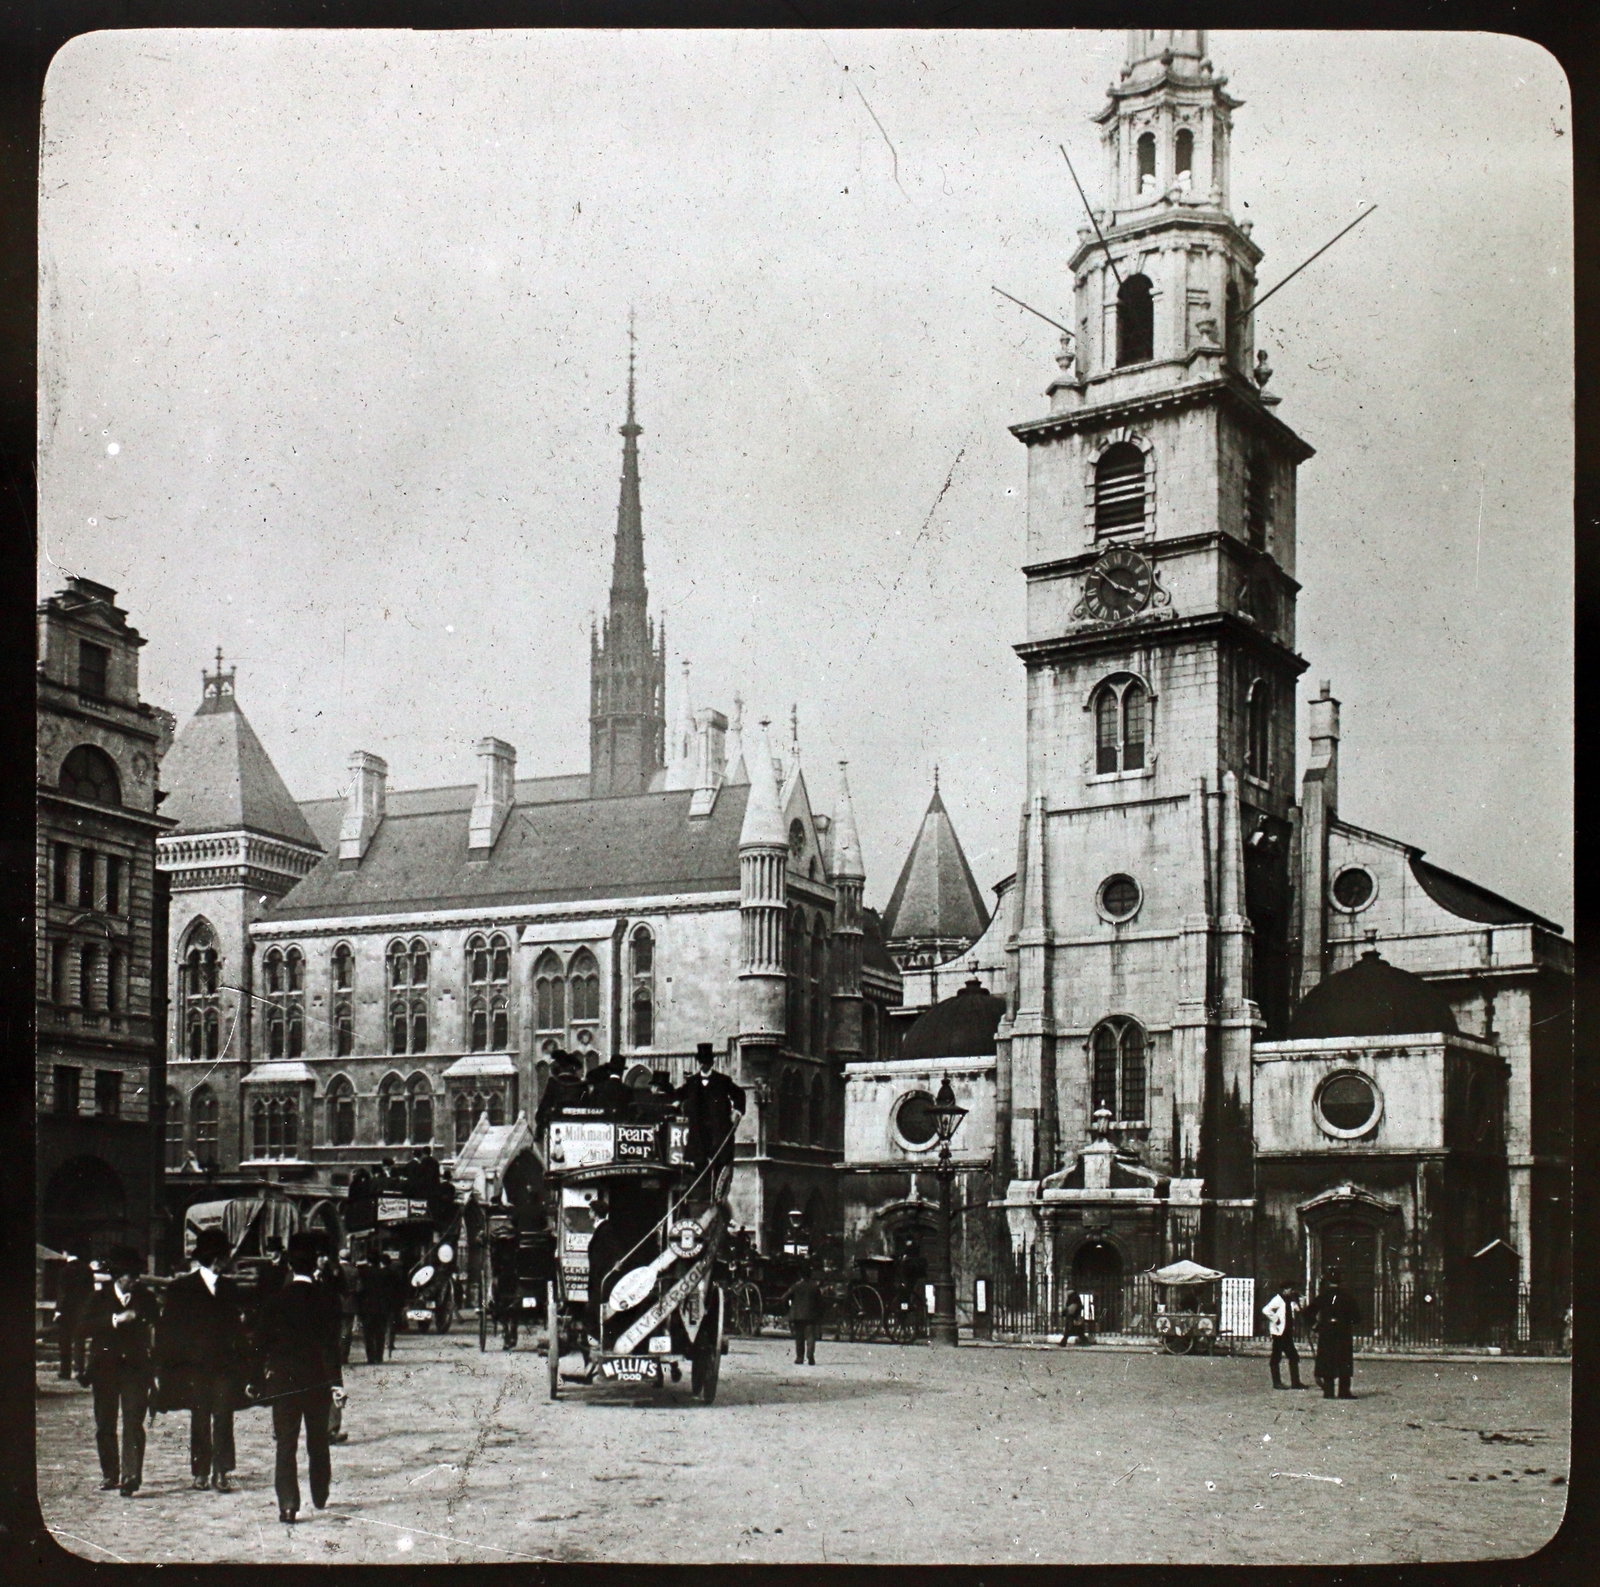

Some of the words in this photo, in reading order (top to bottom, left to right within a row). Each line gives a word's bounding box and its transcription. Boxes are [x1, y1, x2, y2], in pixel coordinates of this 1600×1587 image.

[565, 1125, 612, 1141] Milkmaid
[620, 1143, 651, 1158] Soap
[602, 1358, 658, 1378] MELLIN'S
[617, 1372, 642, 1381] FOOD
